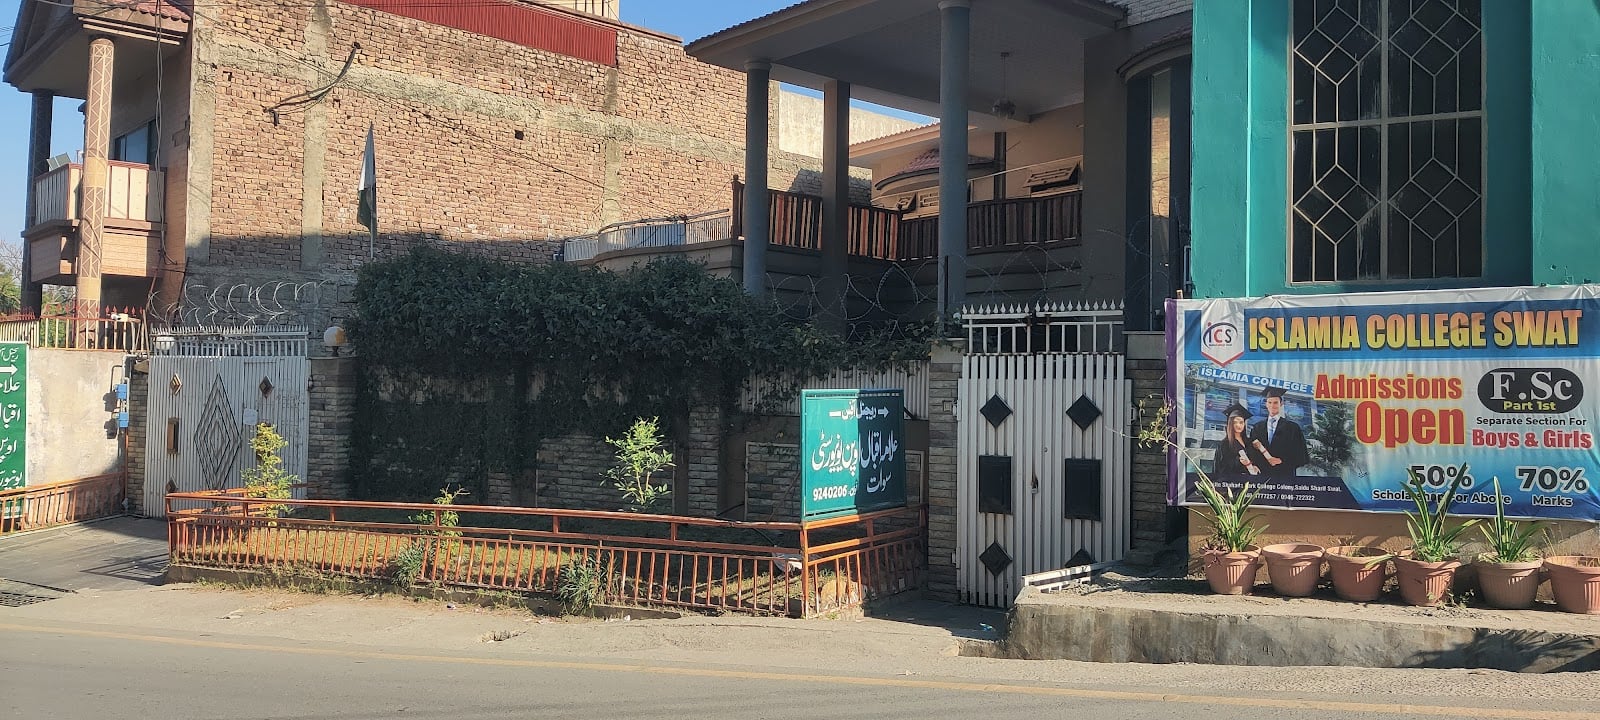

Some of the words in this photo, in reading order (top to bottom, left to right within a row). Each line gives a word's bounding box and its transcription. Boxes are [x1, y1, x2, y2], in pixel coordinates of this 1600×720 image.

[1249, 315, 1361, 350] ISLAMIA
[1366, 312, 1487, 349] COLLEGE
[1493, 309, 1583, 347] SWAT
[1201, 366, 1249, 383] ISLAMIA
[1252, 377, 1308, 392] COLLEGE
[1315, 373, 1462, 399] Admissions
[1503, 401, 1533, 410] Part
[1537, 401, 1556, 410] 1st
[1356, 400, 1465, 448] Open
[1476, 417, 1523, 426] Separate
[1526, 417, 1566, 426] Section
[1570, 418, 1587, 426] For
[860, 430, 881, 469] اقبال
[1472, 429, 1520, 448] Boys
[1524, 432, 1539, 447] &
[1543, 430, 1592, 448] Girls
[867, 467, 892, 492] سوات
[1410, 466, 1472, 487] 50%
[1518, 468, 1587, 490] 70%
[813, 485, 848, 501] 9240206
[1532, 495, 1572, 506] Marks
